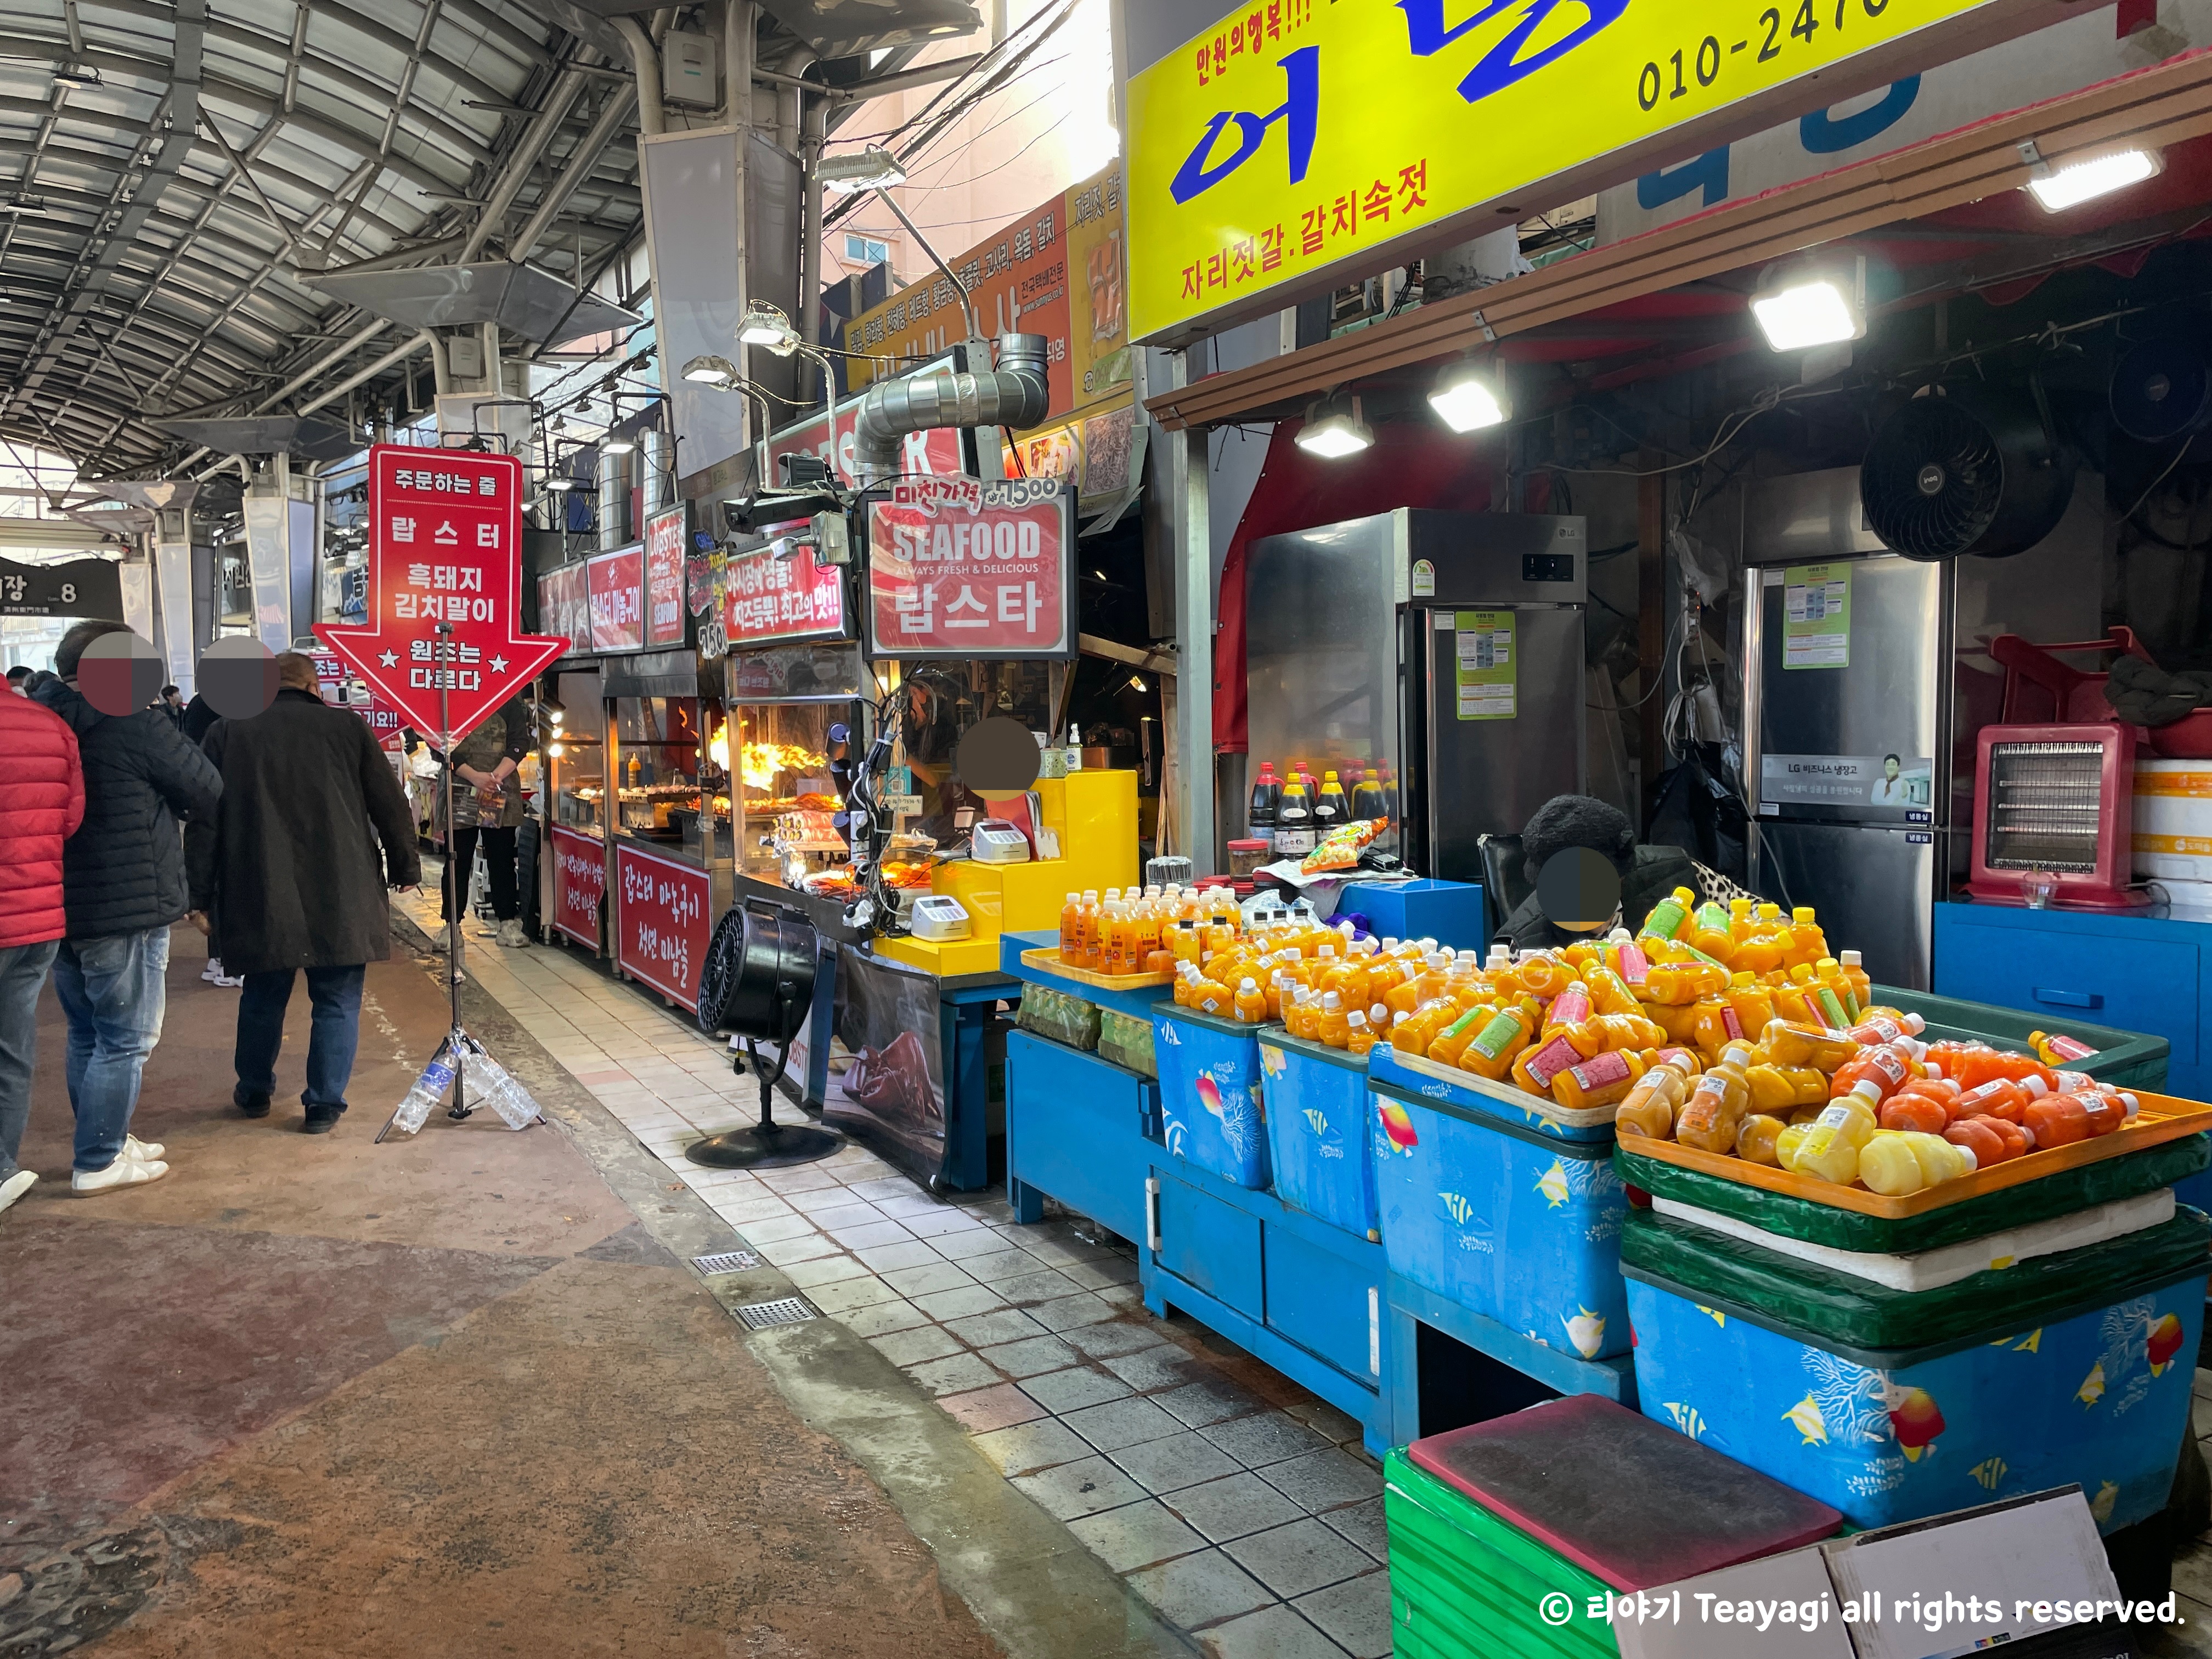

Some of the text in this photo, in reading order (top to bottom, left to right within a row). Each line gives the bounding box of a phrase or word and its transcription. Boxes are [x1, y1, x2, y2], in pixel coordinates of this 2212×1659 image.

[985, 239, 1012, 279] 고사리,
[1036, 211, 1056, 252] 갈치
[1022, 261, 1064, 300] 전국택배전문
[395, 469, 496, 496] 주문하는 줄
[895, 479, 980, 512] 미친가격
[893, 521, 1040, 562] SEAFOOD
[408, 563, 482, 592] 흑돼지
[896, 563, 1039, 576] ALWAYS FRESH & DELICIOUS
[0, 575, 77, 603] 장 8
[814, 583, 839, 620] 맛!!
[394, 593, 494, 623] 김치말이
[654, 600, 678, 626] SEAFOOD
[894, 580, 1043, 634] 랍스타
[409, 639, 481, 664] 원조는
[409, 667, 482, 691] 다르다
[1788, 764, 1858, 776] LG 비즈니스 냉장고
[625, 863, 653, 905] 랍스터
